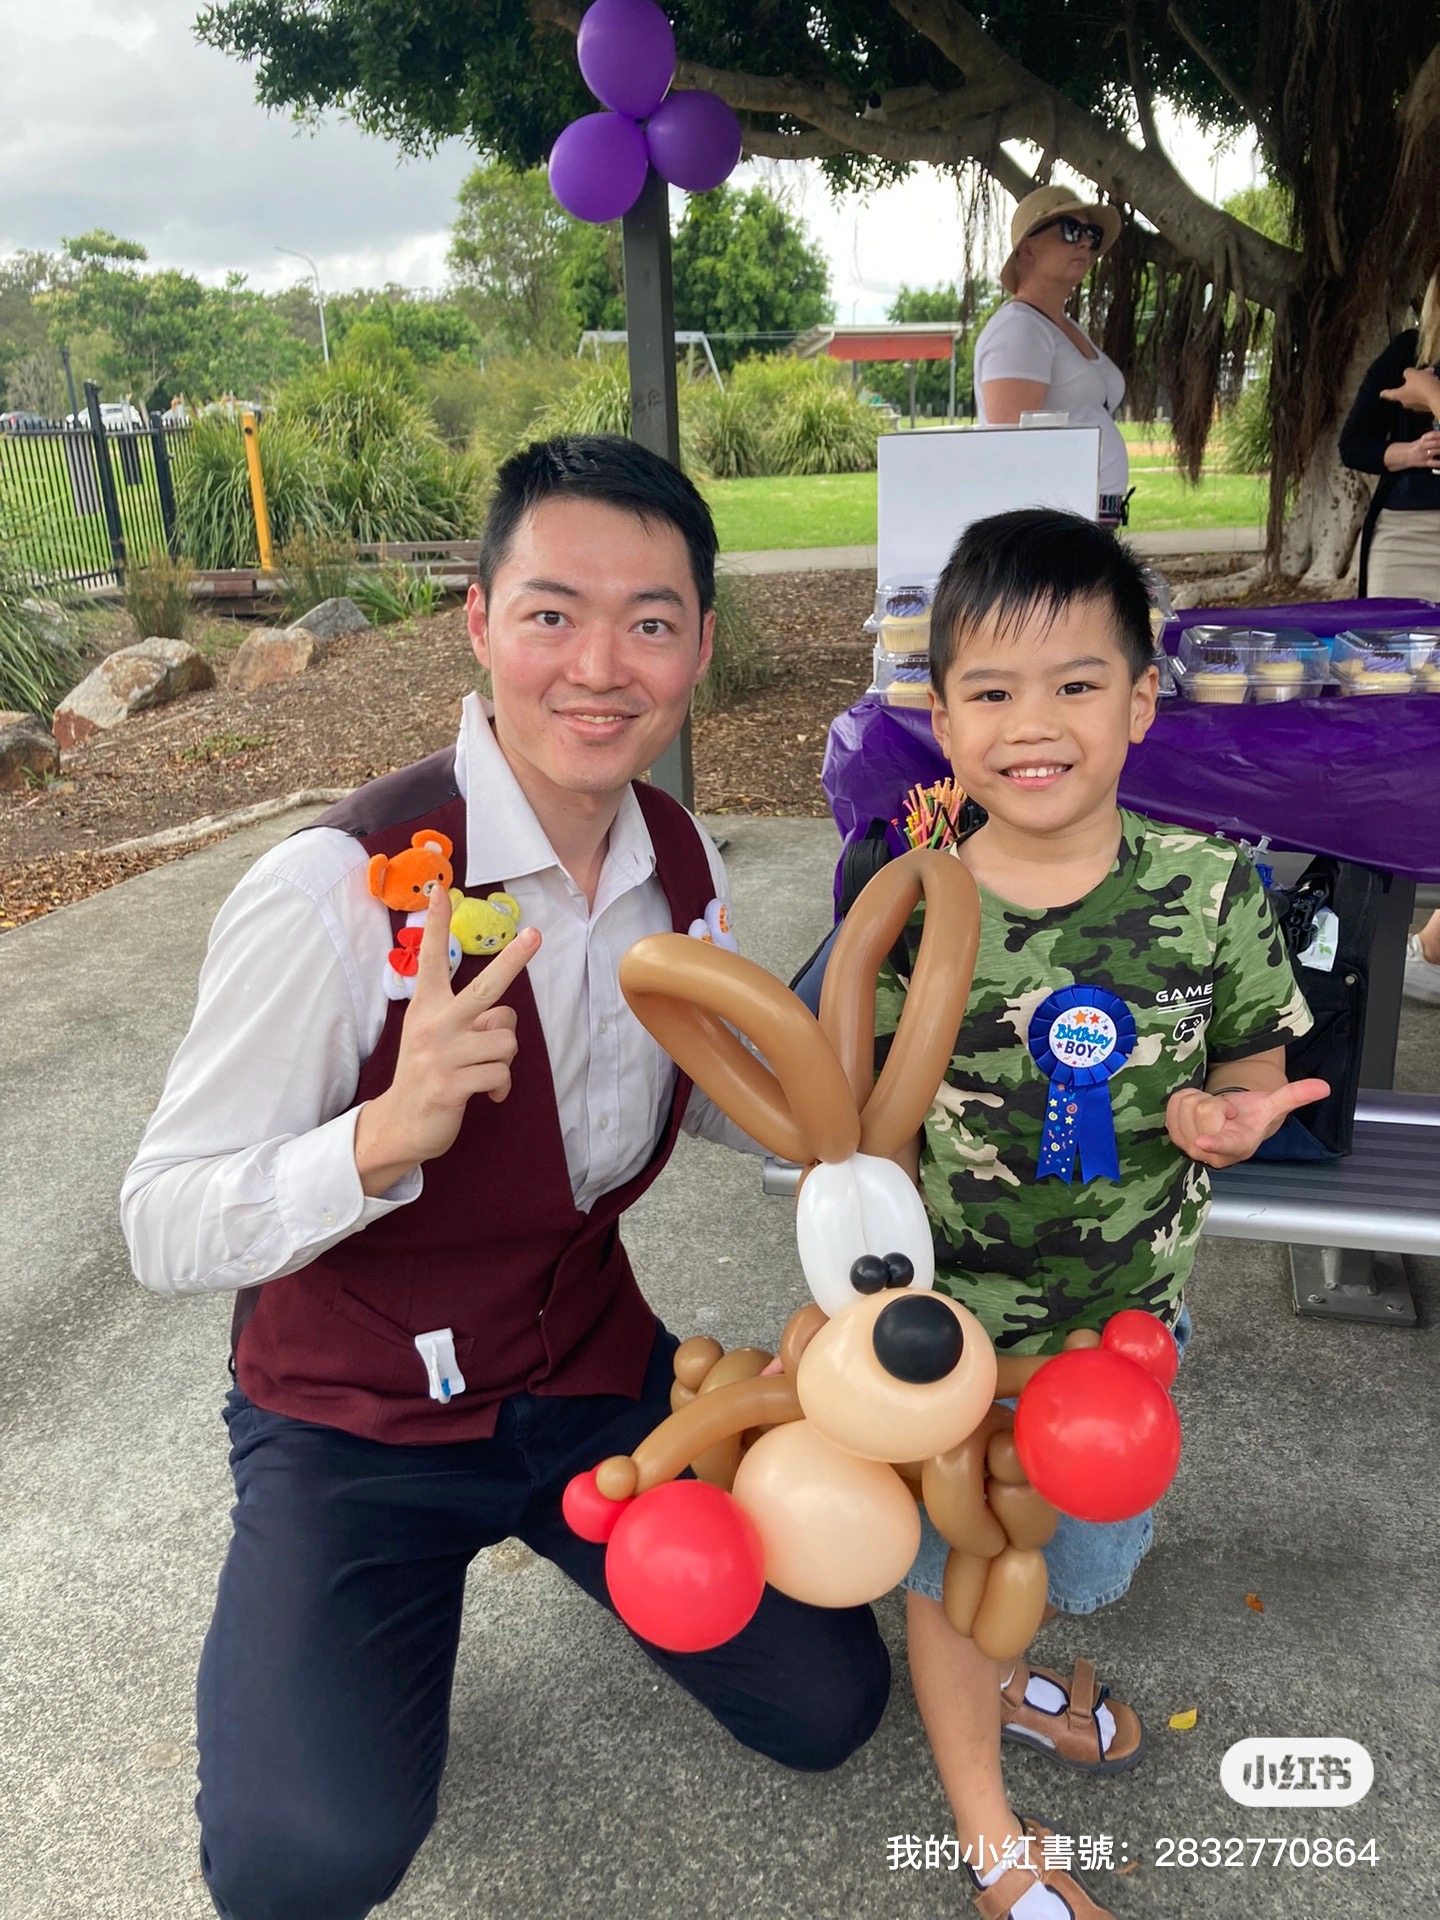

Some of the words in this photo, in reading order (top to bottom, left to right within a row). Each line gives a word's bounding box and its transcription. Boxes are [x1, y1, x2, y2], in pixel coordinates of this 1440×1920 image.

[1155, 982, 1214, 1003] GAME
[1054, 1023, 1114, 1050] Birthday
[1064, 1040, 1098, 1058] BOY
